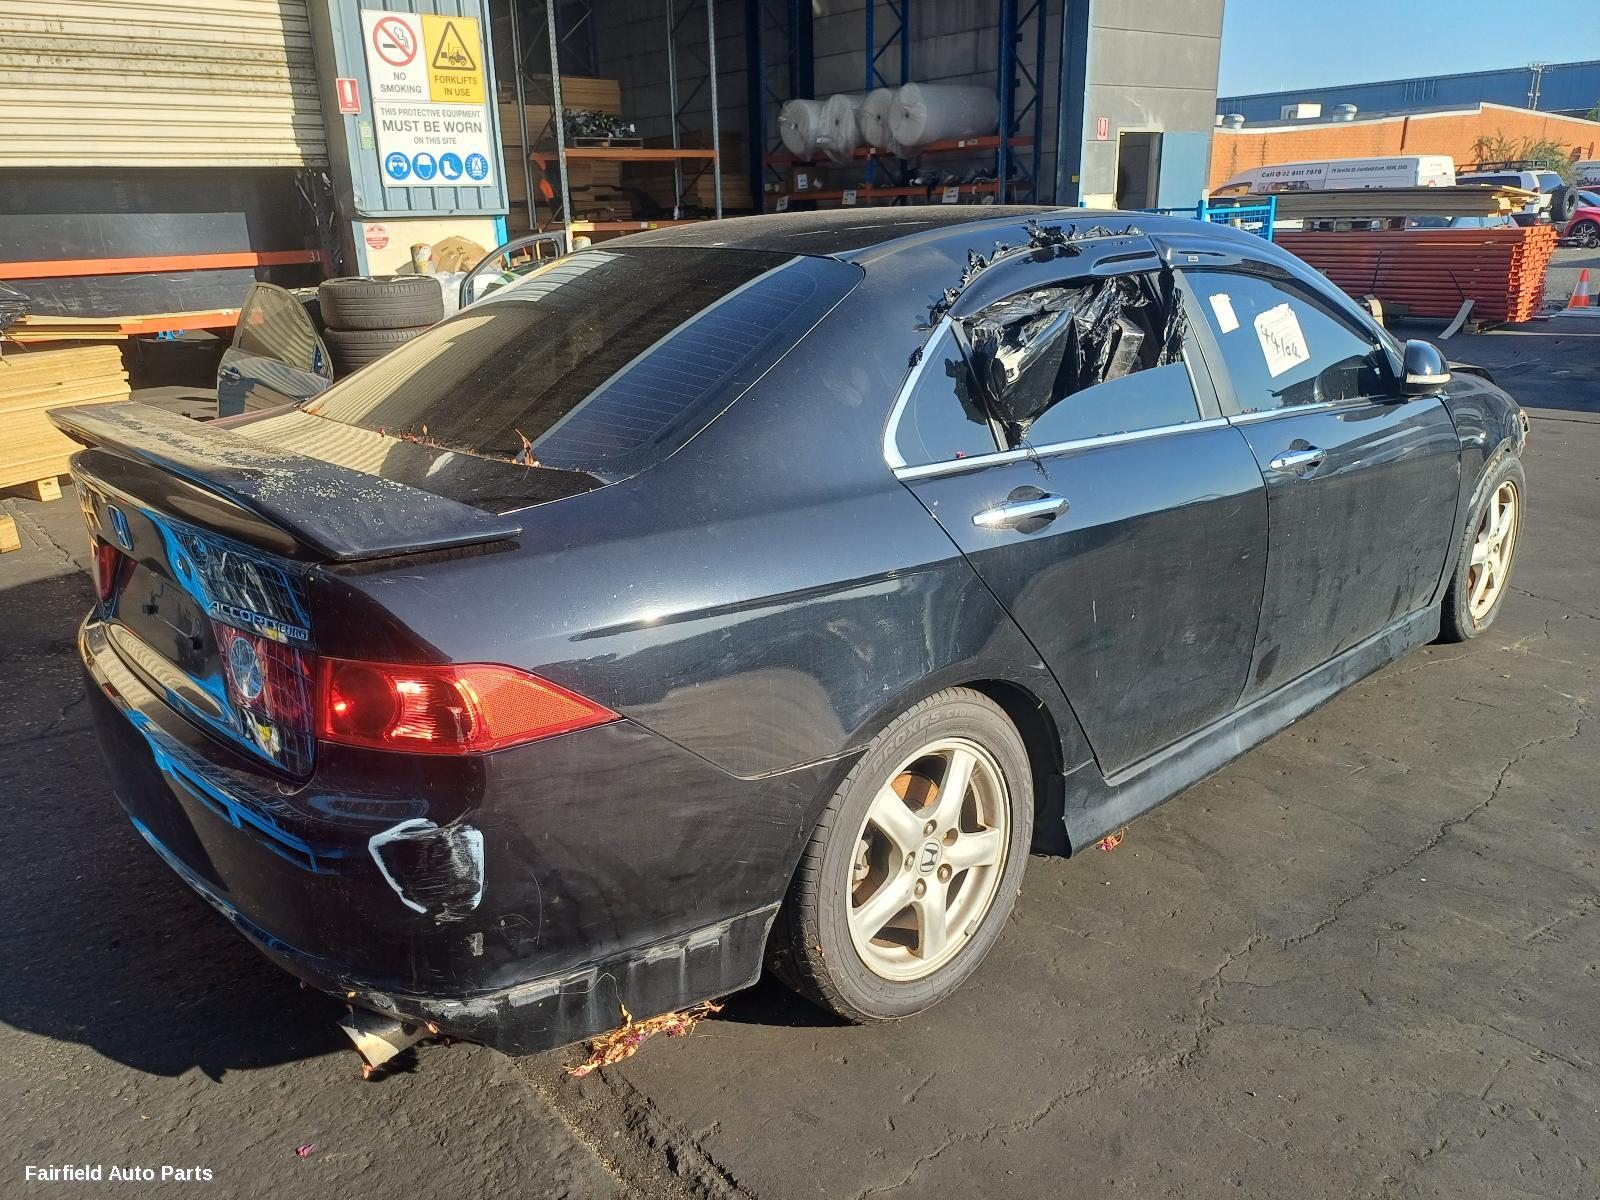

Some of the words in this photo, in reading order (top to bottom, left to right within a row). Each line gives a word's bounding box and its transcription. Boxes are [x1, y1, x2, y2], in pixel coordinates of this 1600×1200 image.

[393, 72, 407, 81] NO
[434, 75, 478, 85] FORKLIFTS
[380, 84, 422, 94] SMOKING
[444, 87, 454, 96] IN
[455, 88, 471, 97] USE
[380, 107, 397, 116] THIS
[398, 108, 441, 118] PROTECTIVE
[442, 109, 481, 118] EQUIPMENT
[382, 119, 420, 133] MUST
[423, 120, 441, 133] BE
[443, 121, 483, 133] WORN
[413, 136, 424, 144] ON
[425, 137, 440, 145] THIS
[442, 137, 457, 145] SITE
[310, 250, 321, 263] 31
[208, 600, 278, 630] ACCORD
[279, 623, 308, 641] EURO
